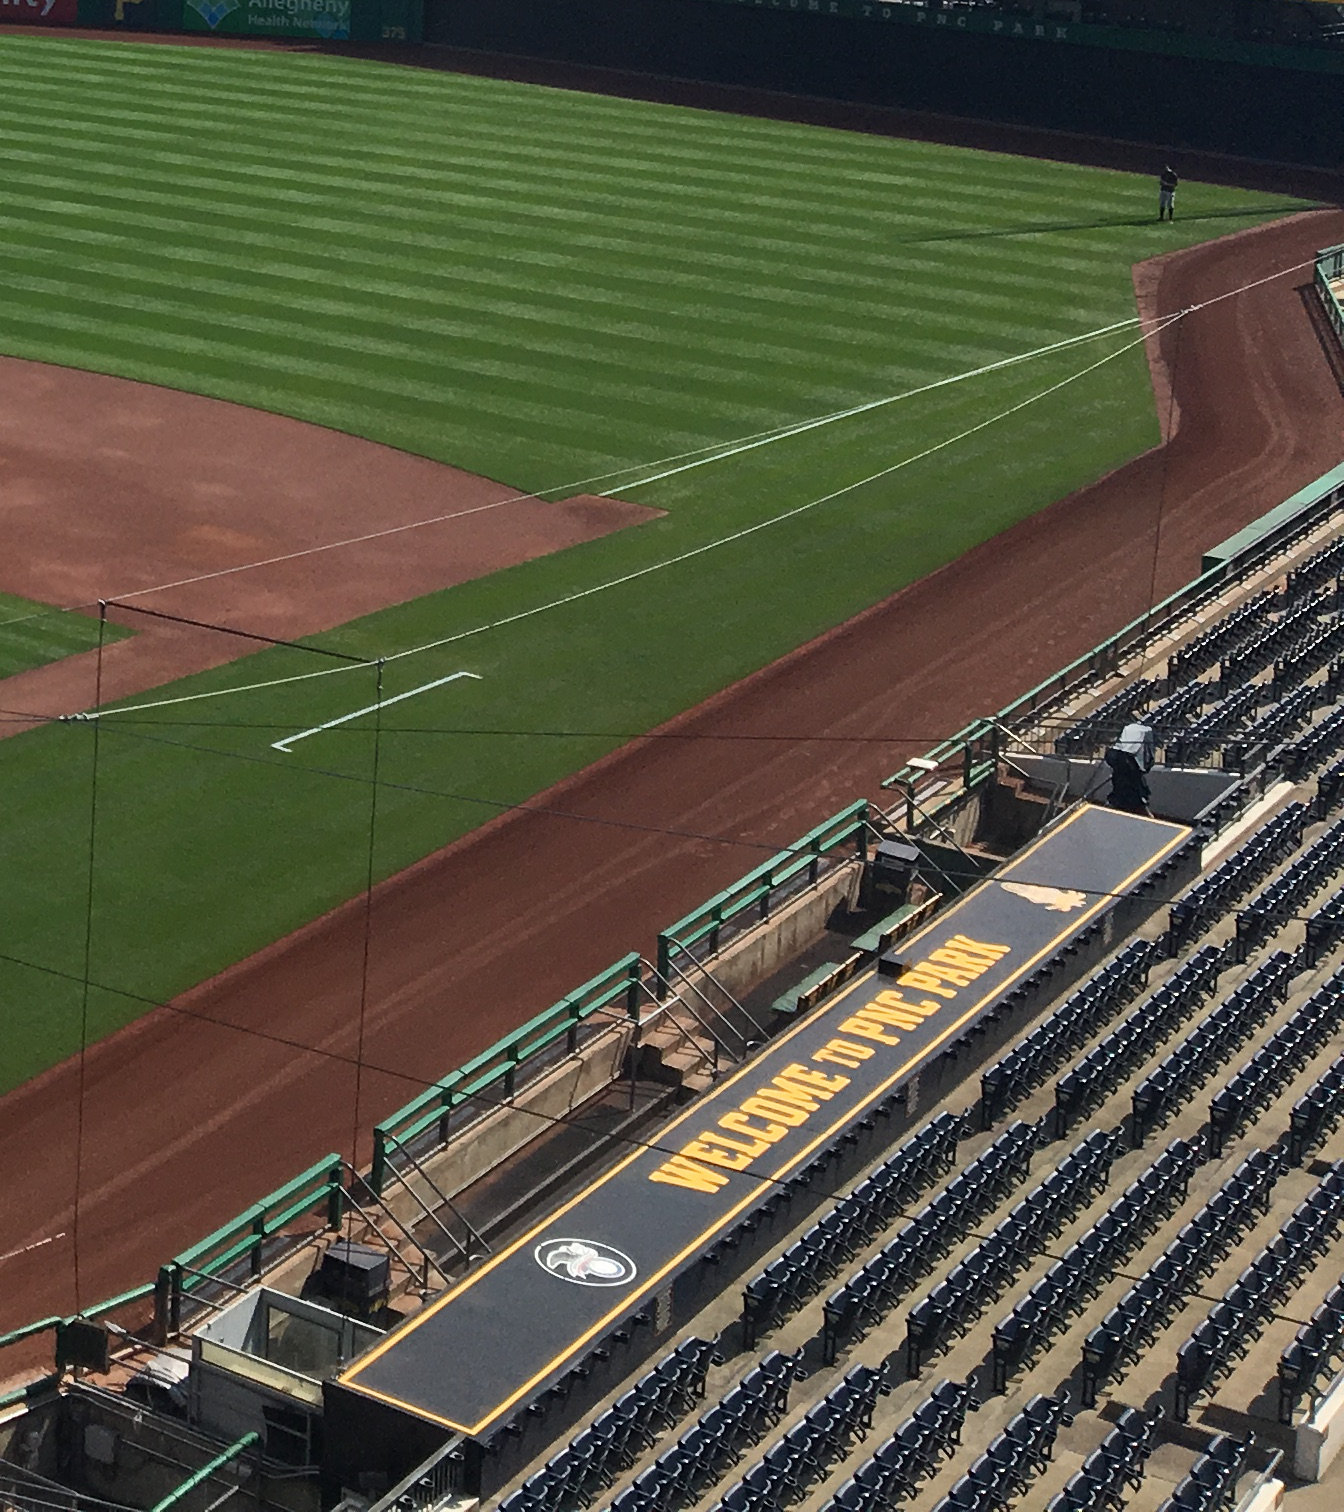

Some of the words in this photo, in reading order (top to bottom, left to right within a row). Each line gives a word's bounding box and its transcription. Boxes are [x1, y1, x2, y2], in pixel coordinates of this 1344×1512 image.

[248, 14, 289, 27] Health
[864, 4, 892, 19] TO
[916, 11, 968, 28] PNC
[992, 19, 1069, 40] PARK
[896, 934, 1011, 999] PARK
[837, 990, 942, 1046] PNC
[812, 1039, 876, 1068] TO
[648, 1063, 851, 1194] WELCOME
